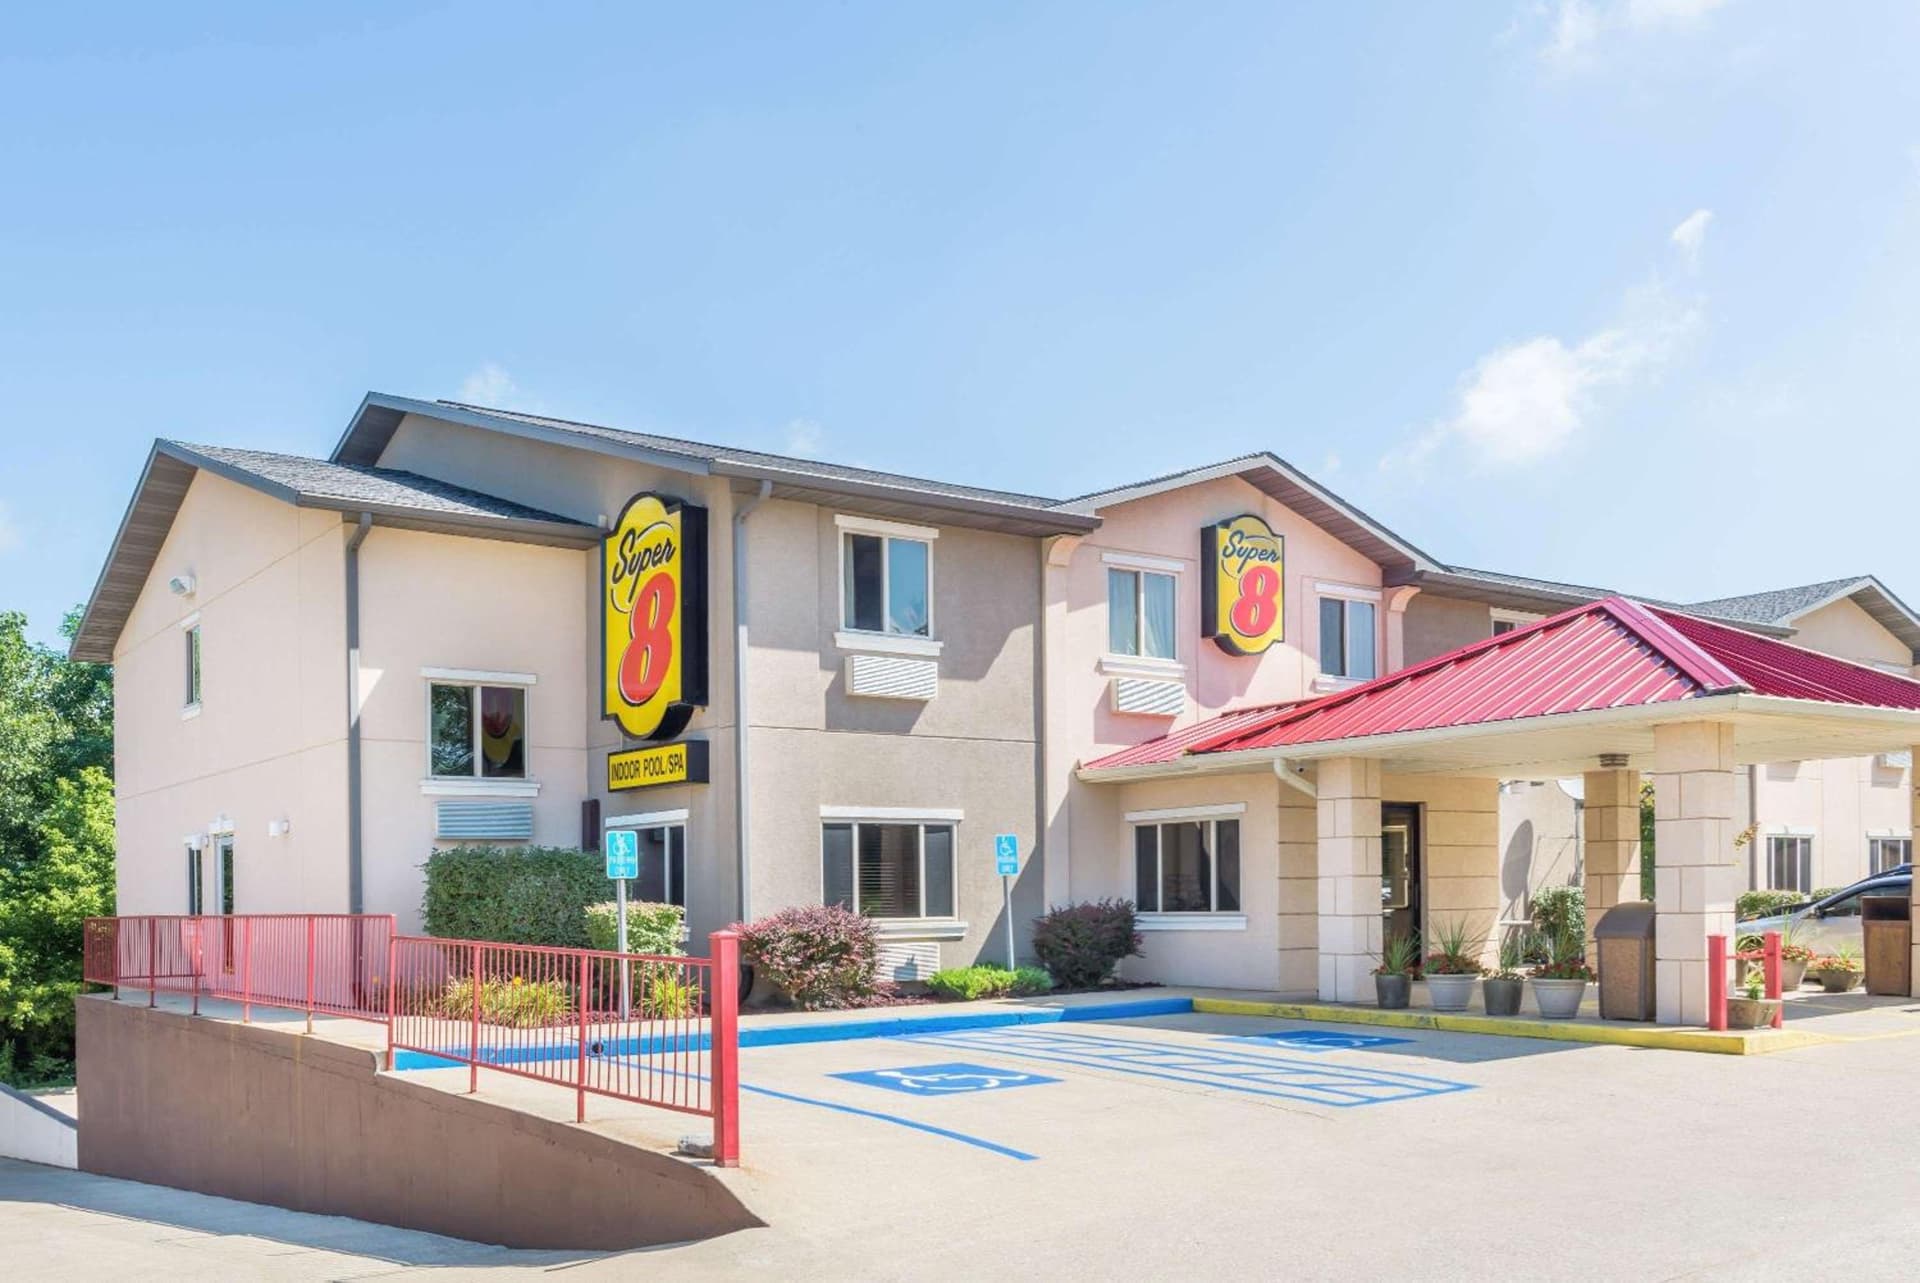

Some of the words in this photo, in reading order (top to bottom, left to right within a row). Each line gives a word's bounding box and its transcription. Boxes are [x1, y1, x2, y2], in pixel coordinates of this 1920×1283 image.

[612, 527, 675, 603] Super
[1222, 530, 1280, 574] Super
[1229, 565, 1280, 637] 8
[618, 571, 676, 707] 8
[611, 760, 640, 781] INDOOR
